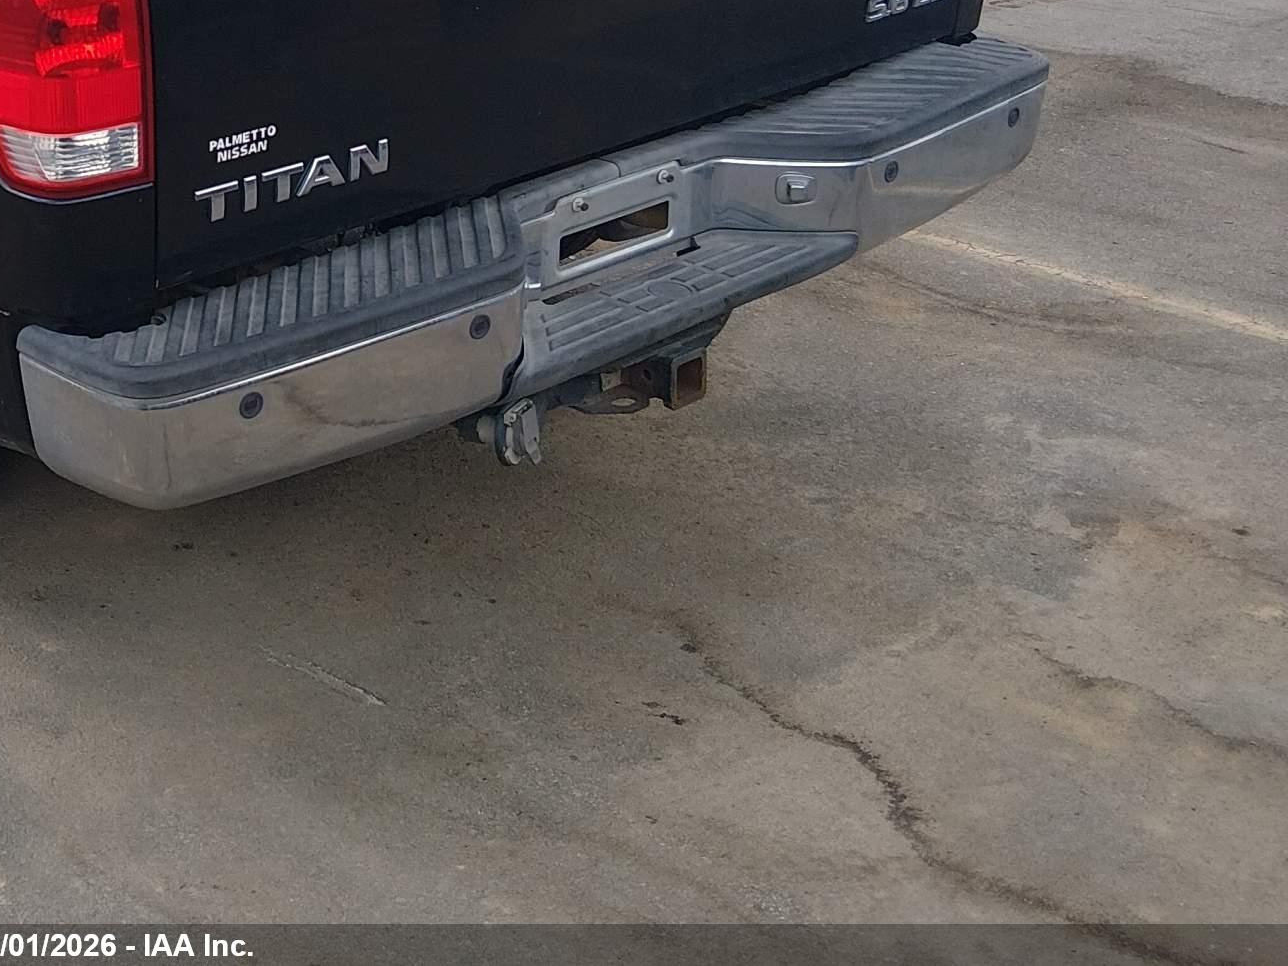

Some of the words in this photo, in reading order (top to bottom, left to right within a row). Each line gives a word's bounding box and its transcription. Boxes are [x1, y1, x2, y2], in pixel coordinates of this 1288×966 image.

[209, 125, 277, 151] PALMETTO
[217, 139, 268, 163] NISSAN
[194, 138, 388, 222] TITAN
